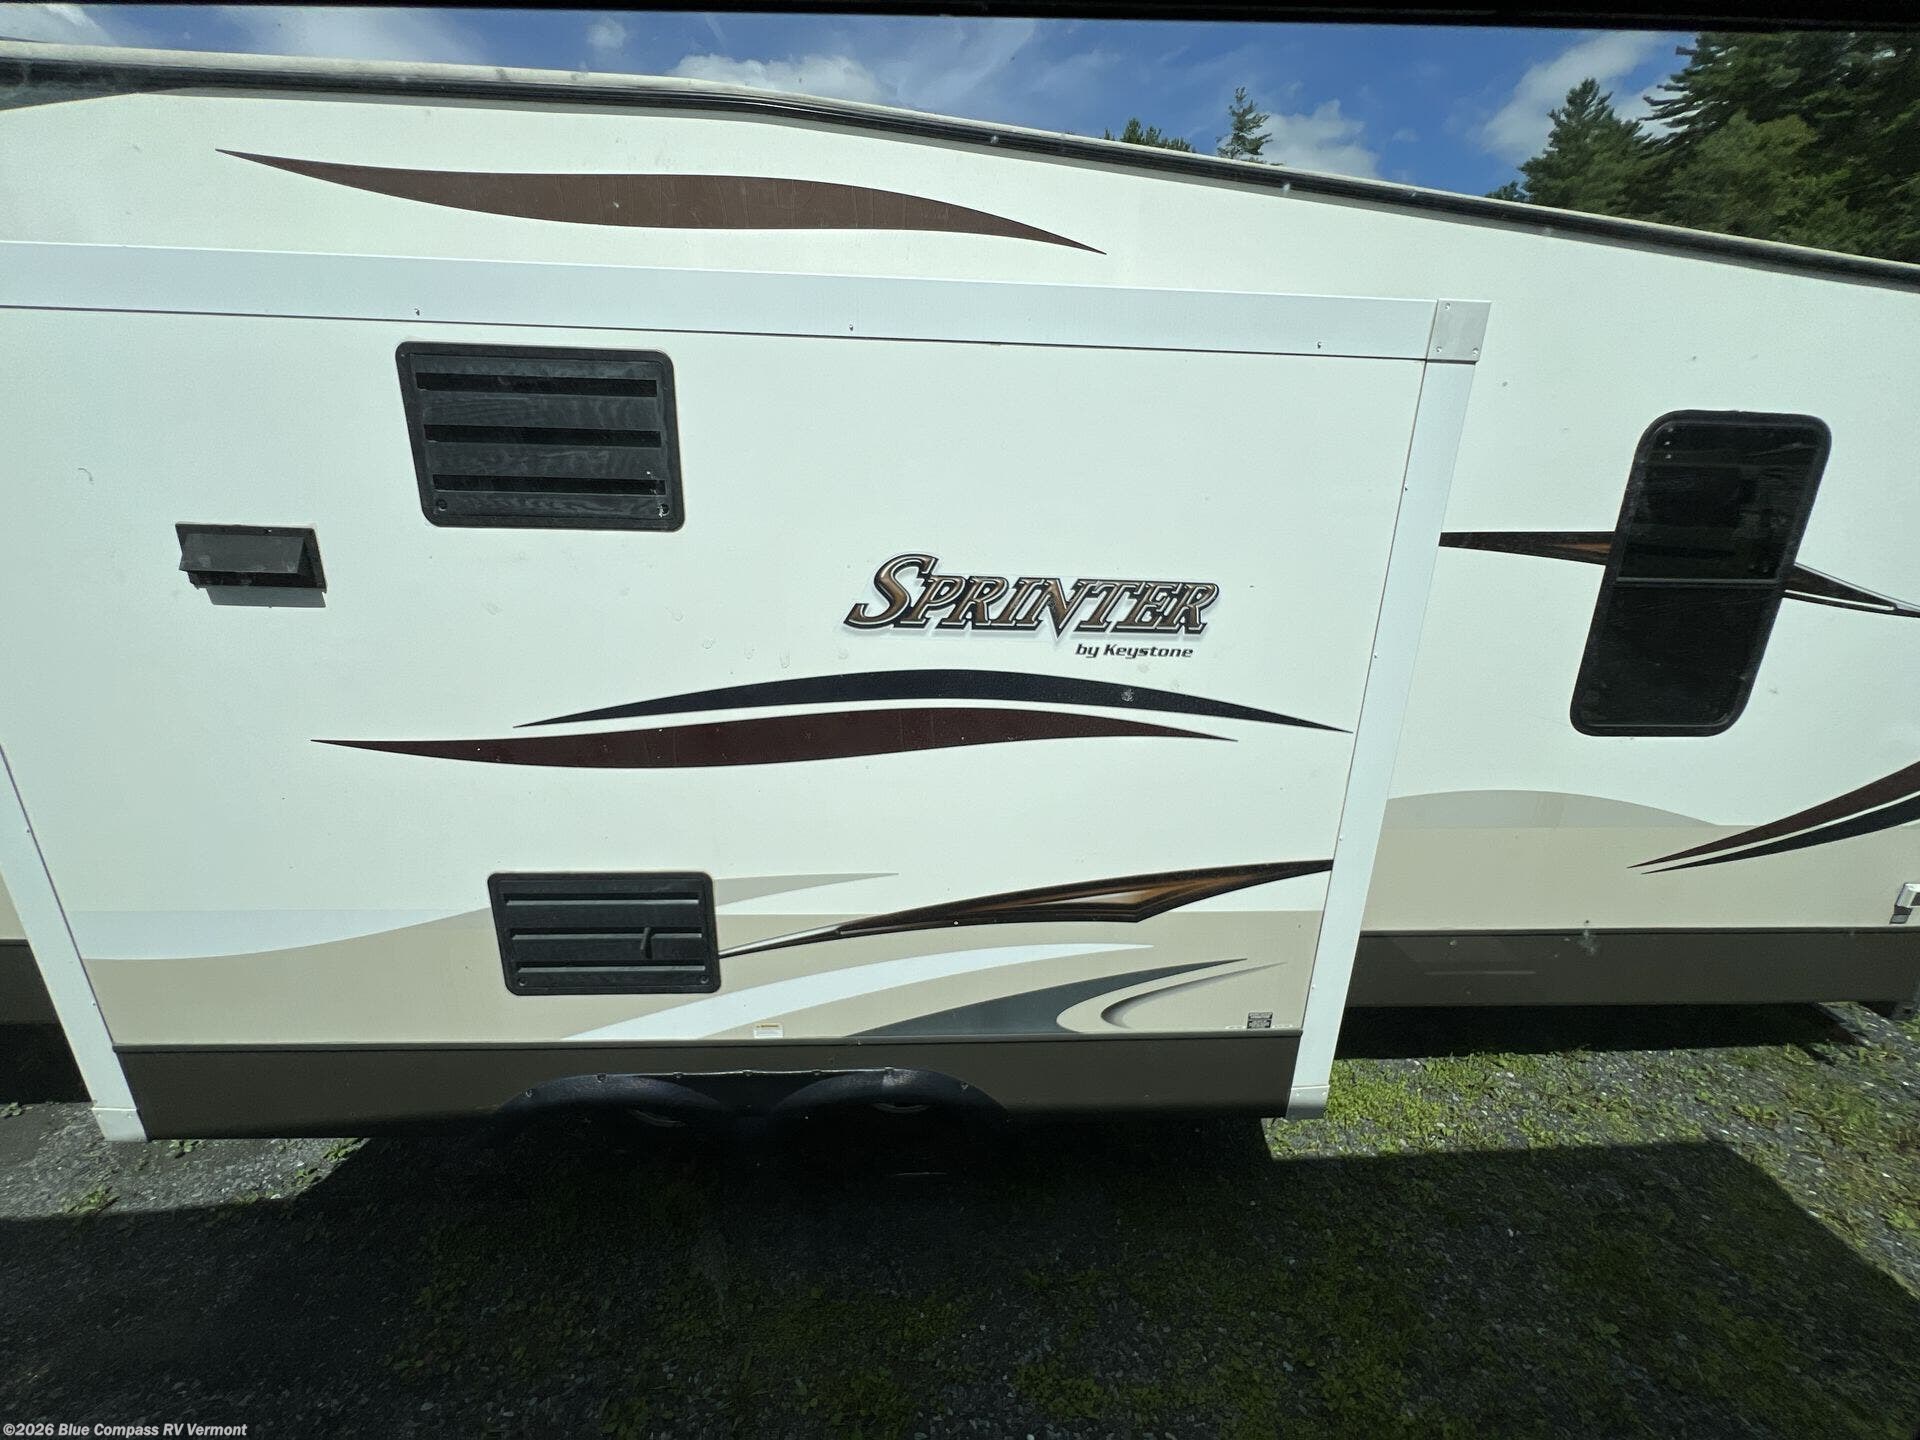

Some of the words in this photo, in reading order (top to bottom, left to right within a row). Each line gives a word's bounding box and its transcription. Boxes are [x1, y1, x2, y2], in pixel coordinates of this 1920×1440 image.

[843, 552, 1220, 639] SPRINTER
[1075, 643, 1100, 659] by
[1103, 643, 1194, 660] Keystone
